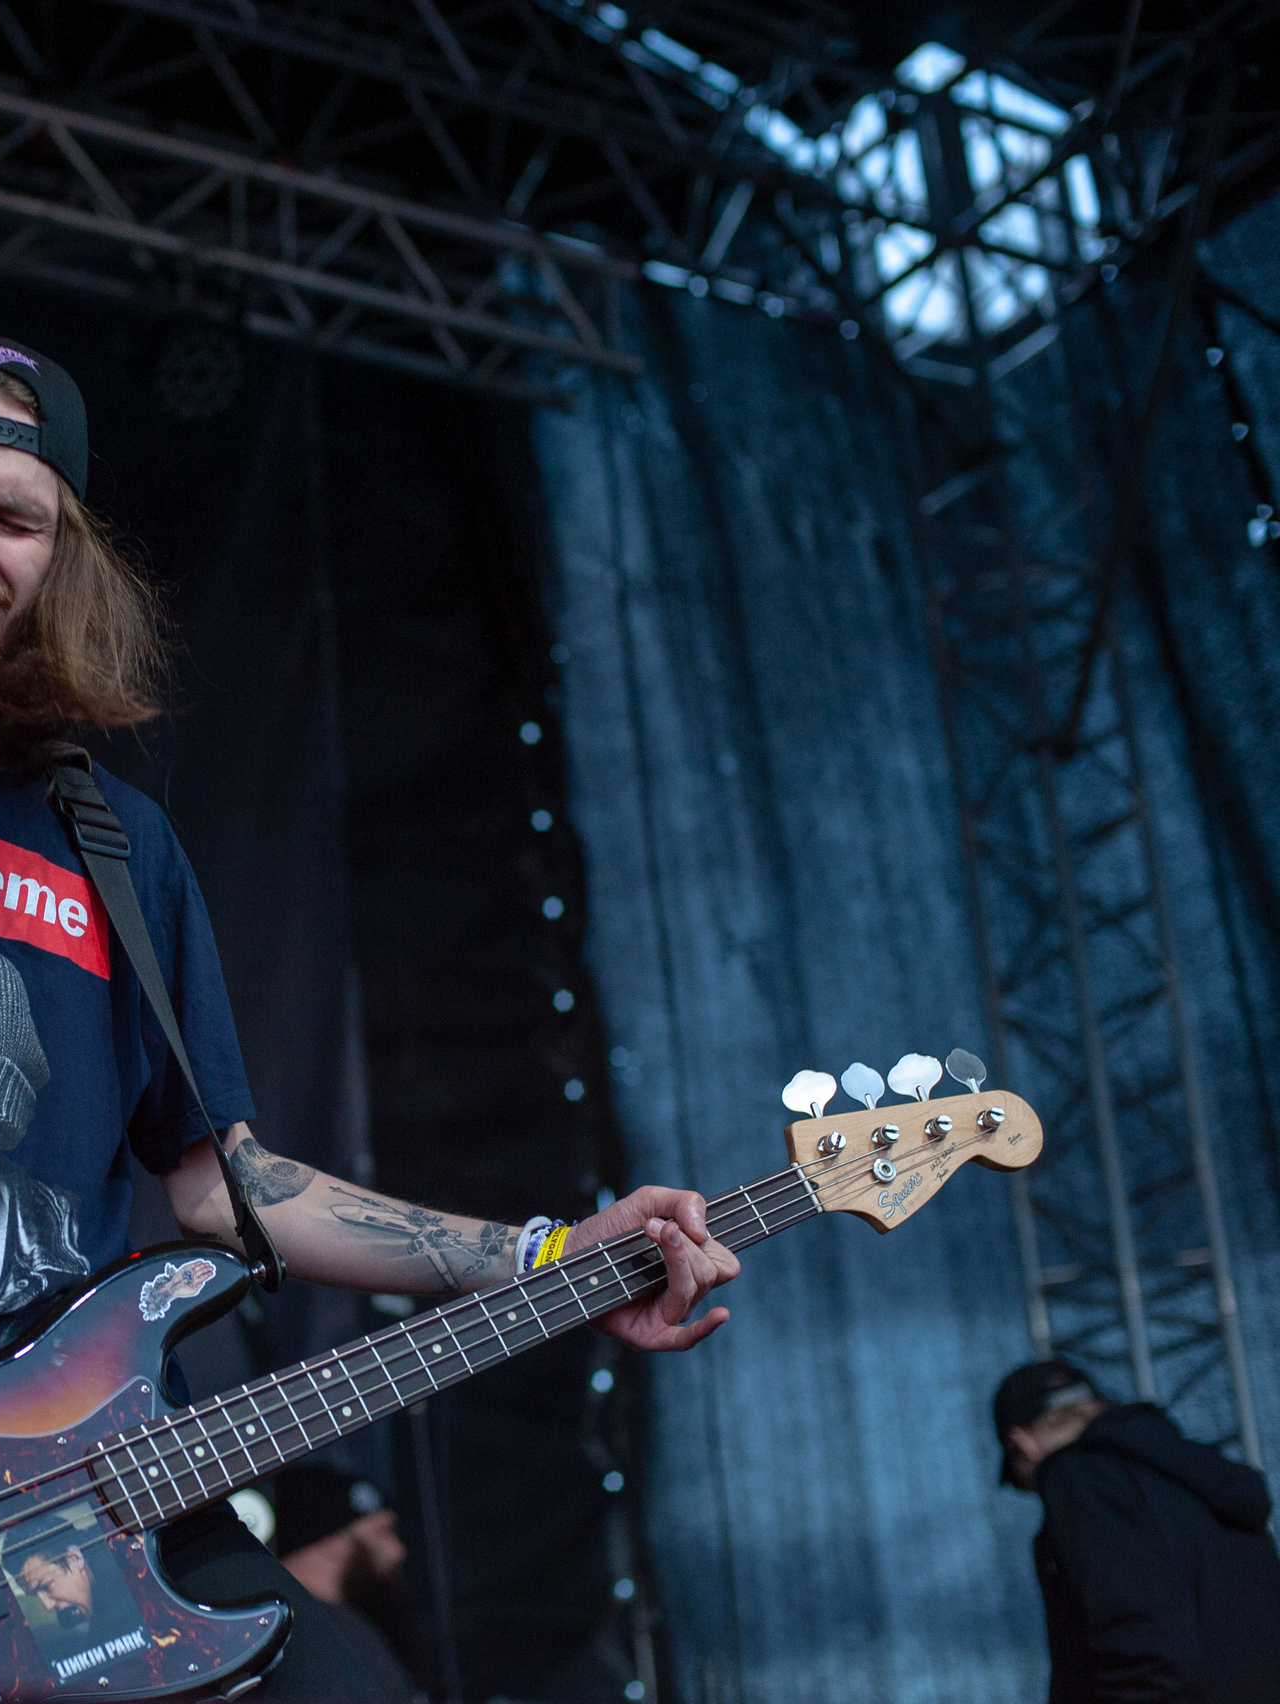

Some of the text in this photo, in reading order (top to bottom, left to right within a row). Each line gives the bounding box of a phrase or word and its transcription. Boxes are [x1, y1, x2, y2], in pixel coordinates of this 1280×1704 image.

[877, 1174, 923, 1220] Squier
[55, 1629, 146, 1679] LINKIN PARK
